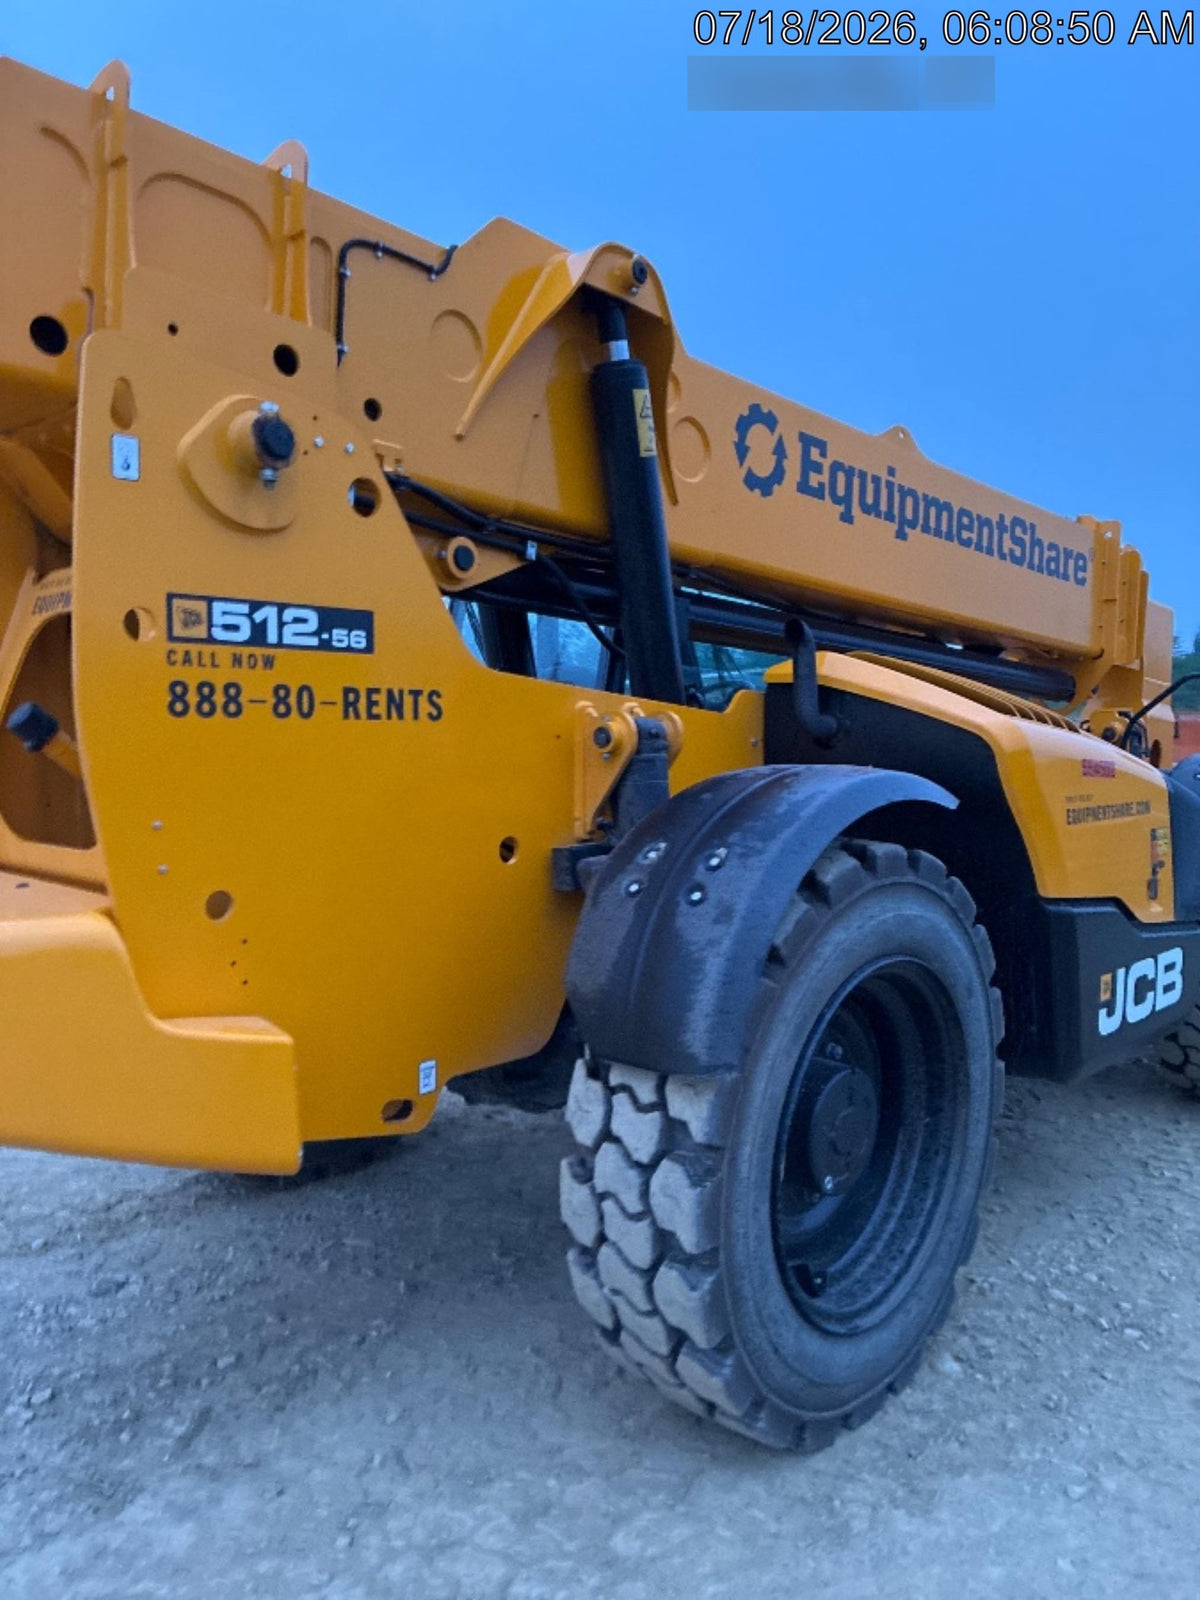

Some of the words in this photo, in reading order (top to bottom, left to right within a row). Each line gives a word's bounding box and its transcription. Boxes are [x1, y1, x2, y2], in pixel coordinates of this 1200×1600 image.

[796, 430, 1088, 587] EquipmentShare
[166, 649, 221, 669] CALL
[232, 652, 276, 671] NOW
[1098, 946, 1184, 1036] JCB
